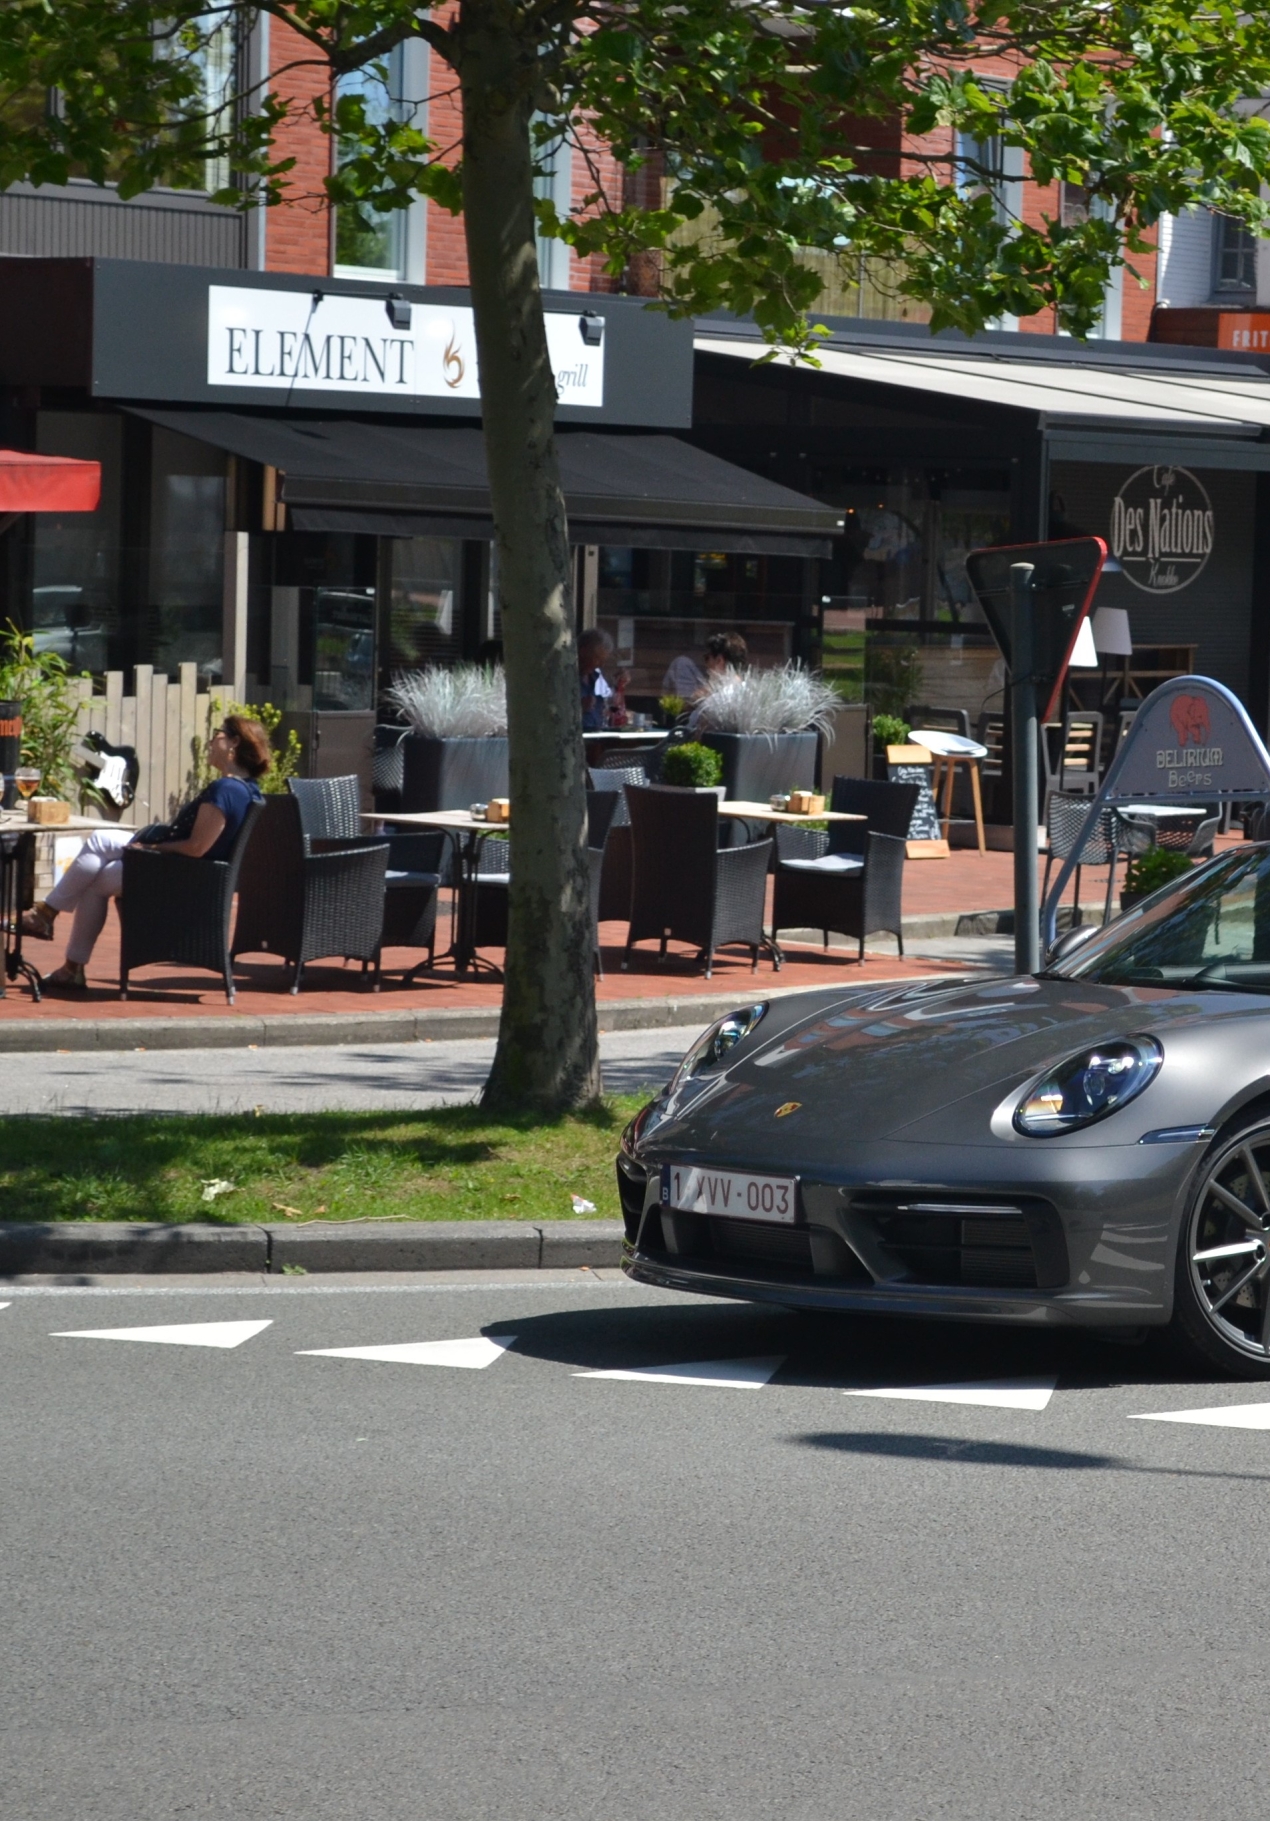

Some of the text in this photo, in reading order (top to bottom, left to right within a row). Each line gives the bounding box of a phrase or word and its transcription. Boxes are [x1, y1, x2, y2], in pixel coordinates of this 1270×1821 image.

[225, 326, 415, 385] ELEMENT
[557, 363, 588, 396] grill
[1113, 494, 1212, 558] Des Nations
[1156, 748, 1223, 769] DELIRIUM
[662, 1187, 669, 1200] B
